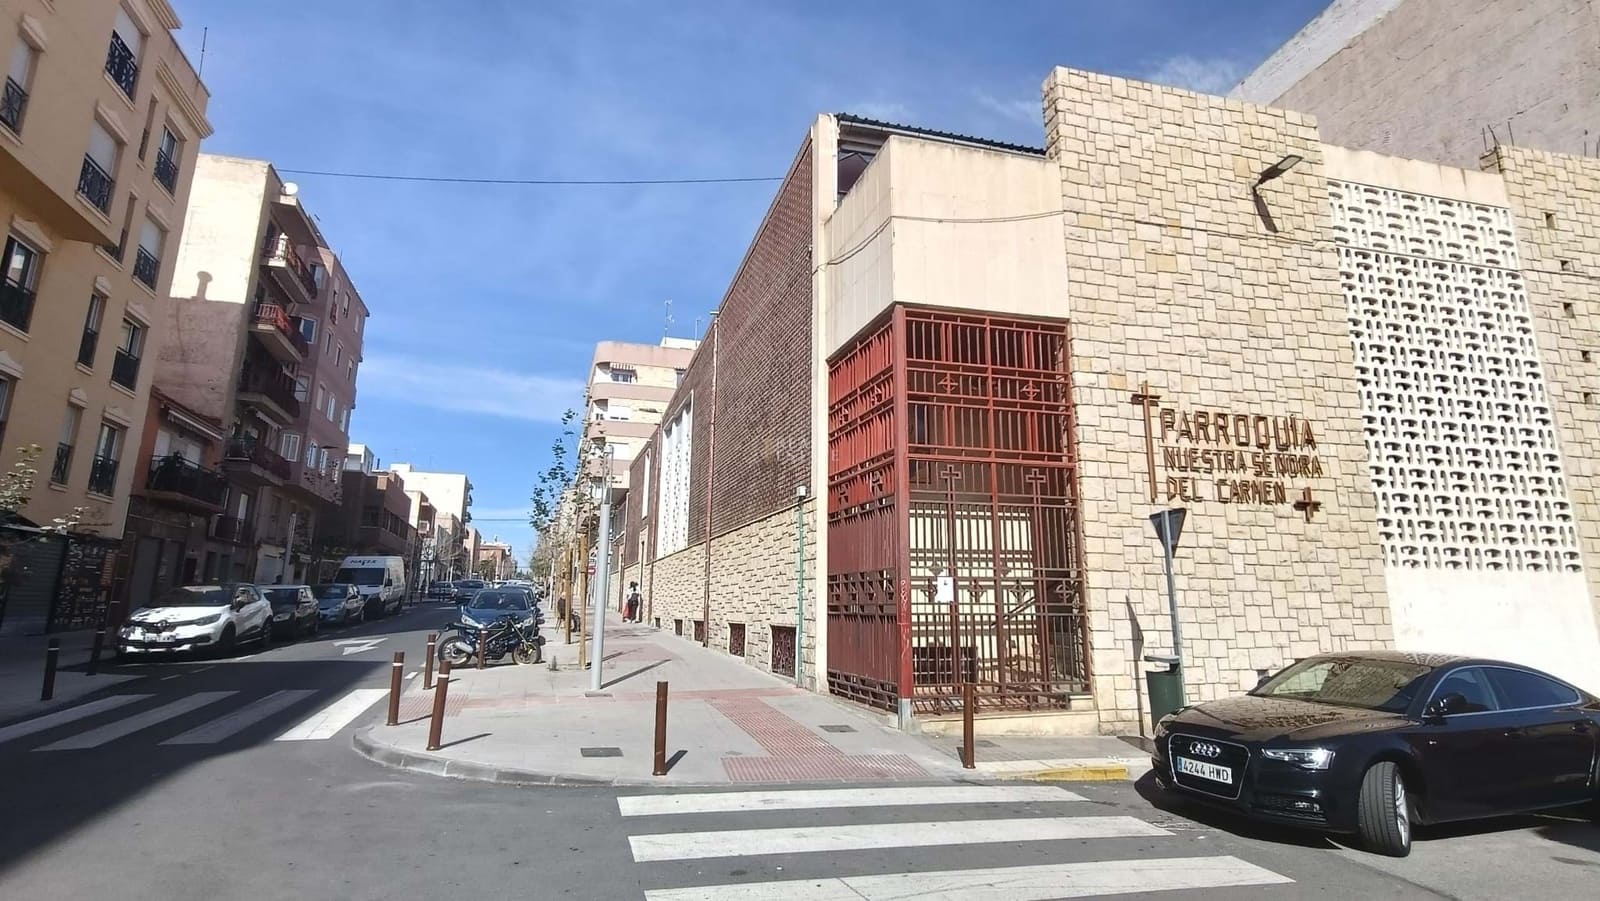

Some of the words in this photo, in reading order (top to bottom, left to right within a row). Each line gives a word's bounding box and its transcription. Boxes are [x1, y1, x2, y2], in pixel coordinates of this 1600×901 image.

[1163, 448, 1247, 474] NUESTRA
[1166, 476, 1203, 502] DEL
[1217, 478, 1286, 505] CARMEN
[1183, 760, 1206, 776] 4244
[1208, 766, 1229, 781] HWD
